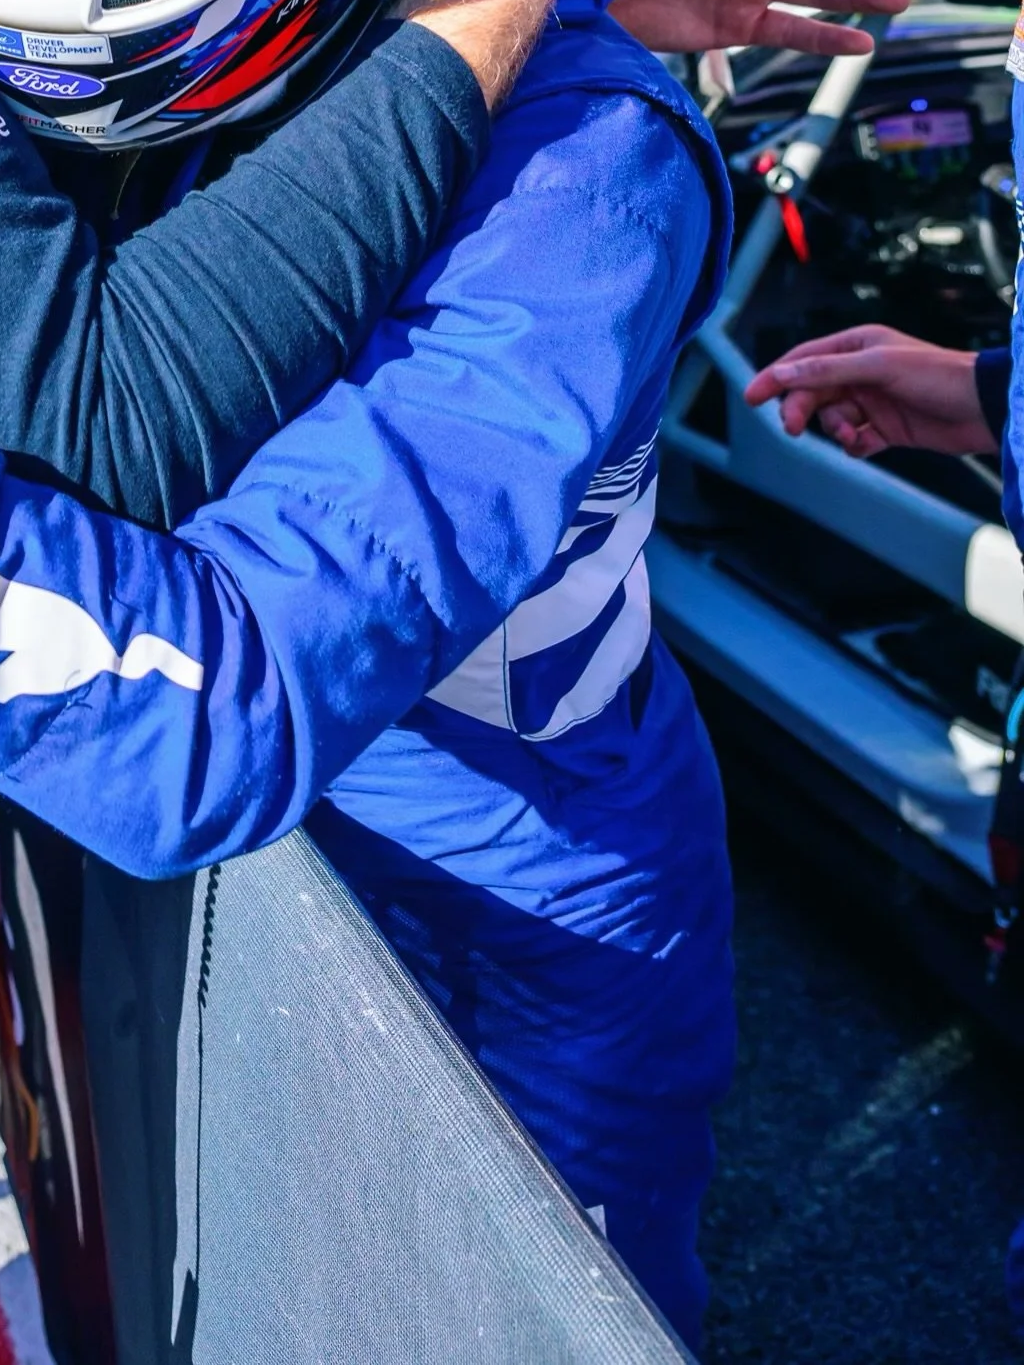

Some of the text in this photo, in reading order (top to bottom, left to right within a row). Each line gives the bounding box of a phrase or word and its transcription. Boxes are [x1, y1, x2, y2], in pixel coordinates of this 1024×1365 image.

[26, 37, 64, 46] DRIVER
[27, 43, 103, 54] DEVELOPMENT
[30, 51, 58, 60] TEAM
[8, 67, 80, 96] Ford
